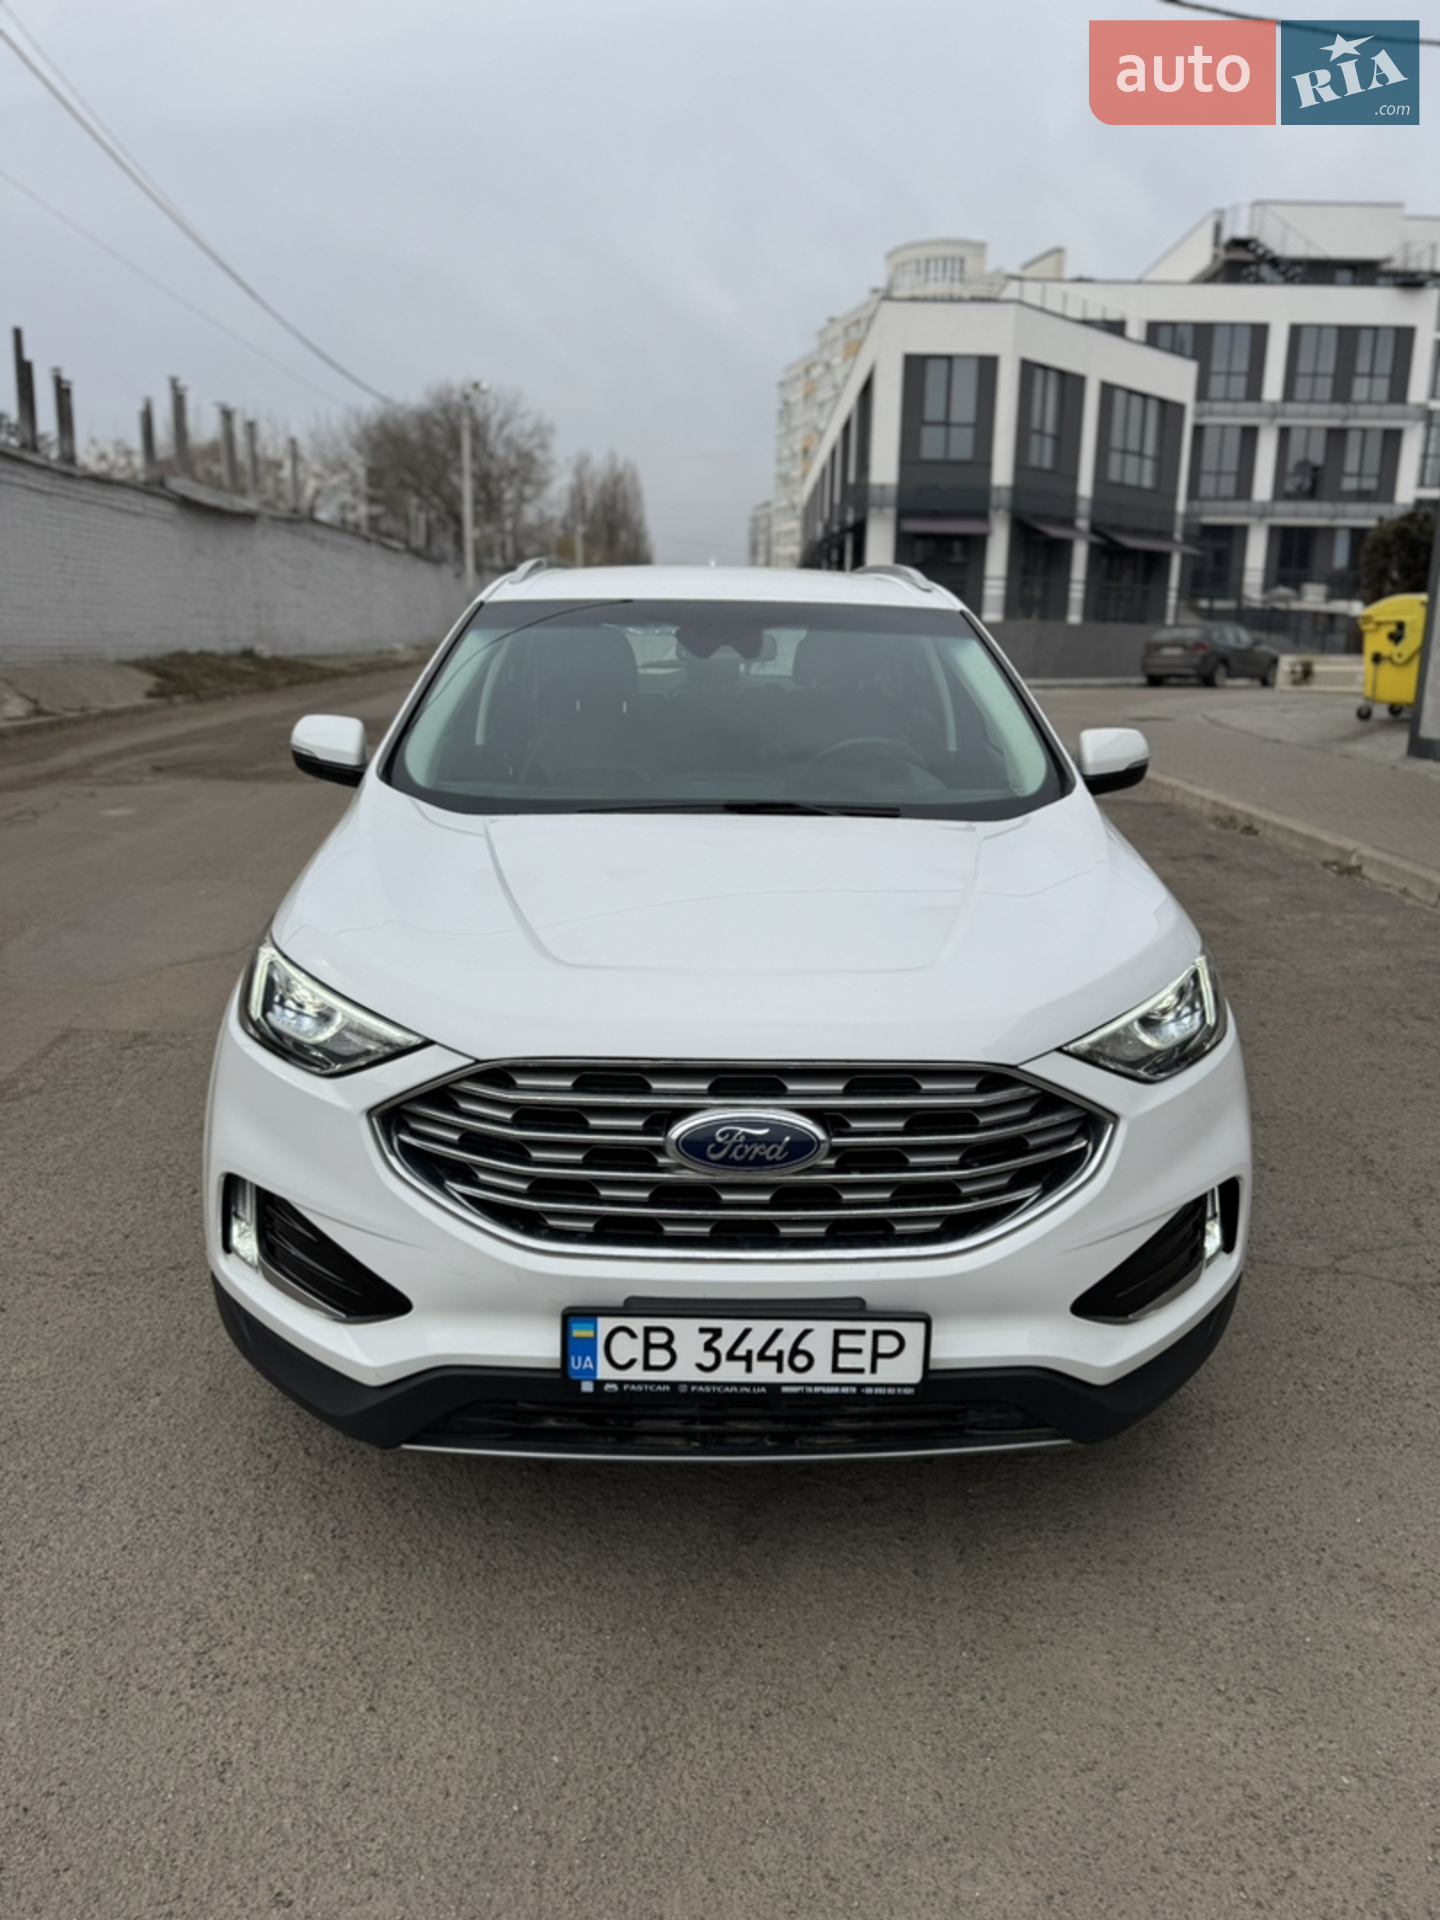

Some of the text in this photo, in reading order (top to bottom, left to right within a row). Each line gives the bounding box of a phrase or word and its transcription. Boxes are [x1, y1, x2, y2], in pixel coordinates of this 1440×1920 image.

[706, 1126, 791, 1161] Ford
[570, 1355, 594, 1370] UA
[603, 1325, 906, 1375] CB 3446 EP
[623, 1384, 671, 1393] FASTCAR
